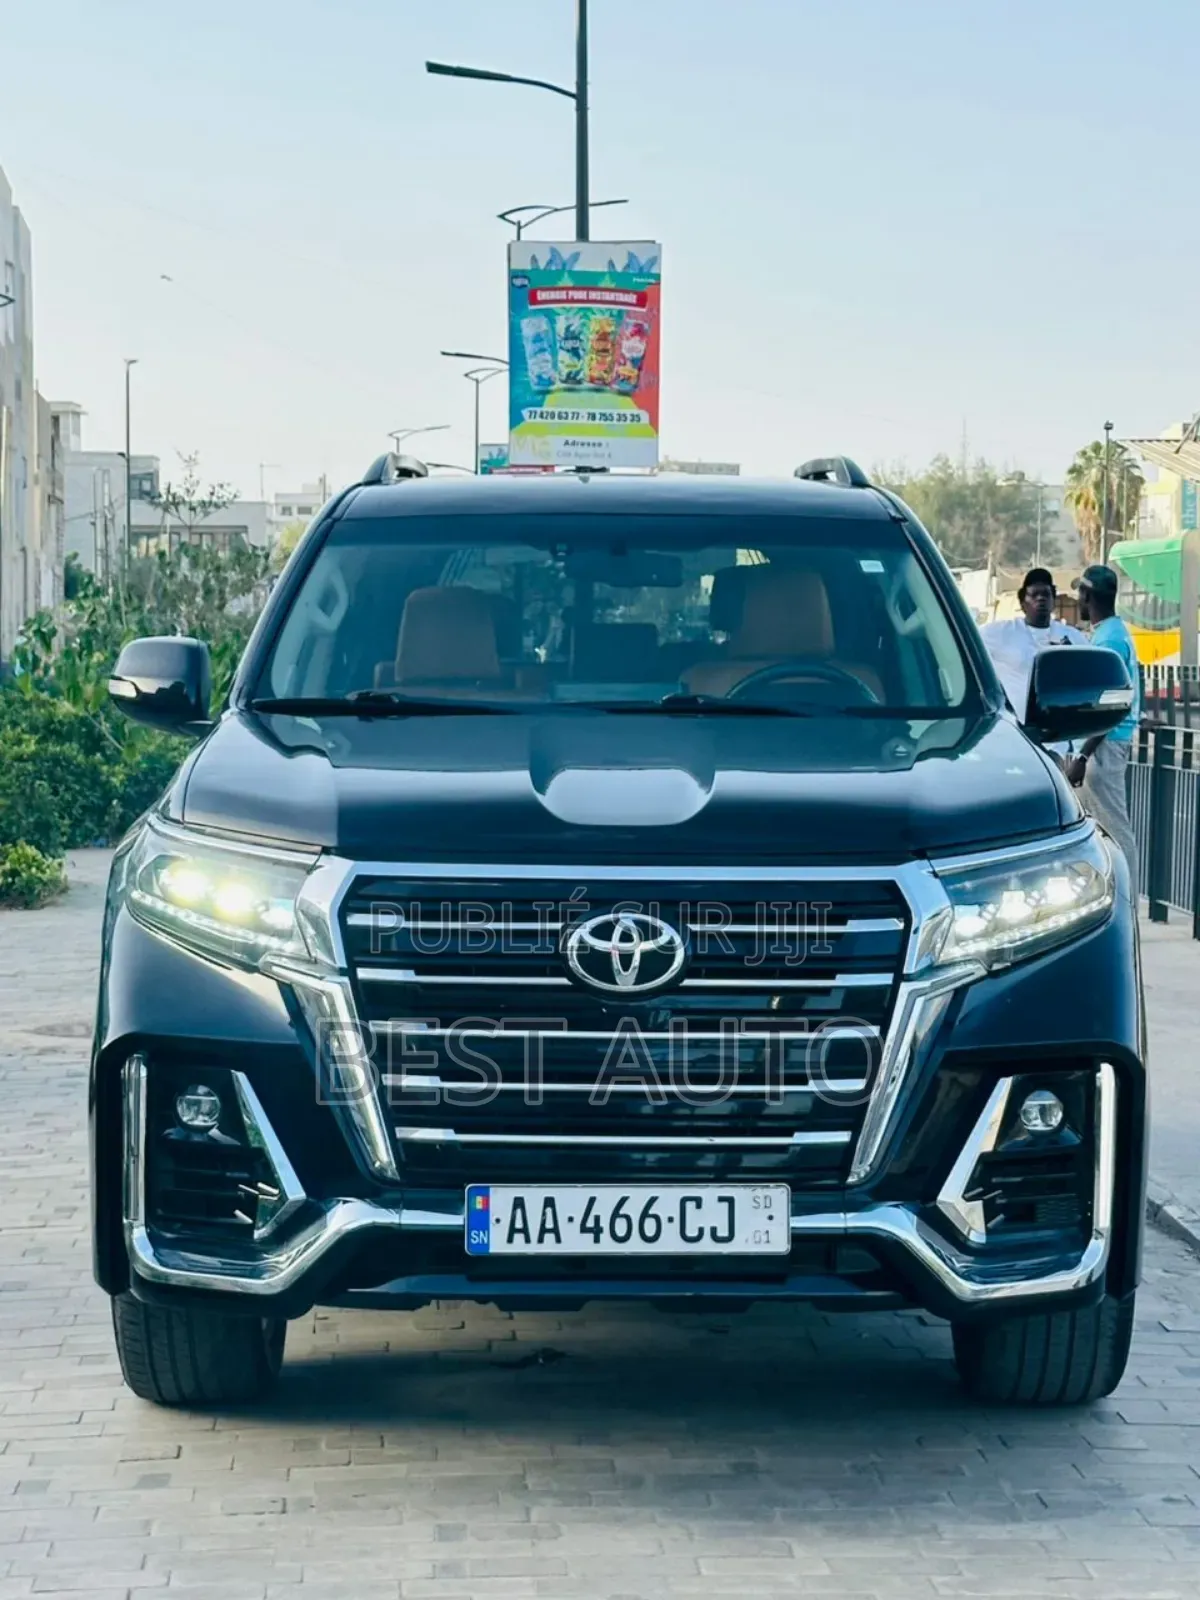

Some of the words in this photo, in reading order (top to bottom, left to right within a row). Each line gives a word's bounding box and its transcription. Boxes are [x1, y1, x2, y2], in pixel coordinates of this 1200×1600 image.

[528, 410, 537, 419] 77
[570, 411, 580, 420] 77
[752, 1195, 772, 1209] SD
[471, 1231, 488, 1244] SN
